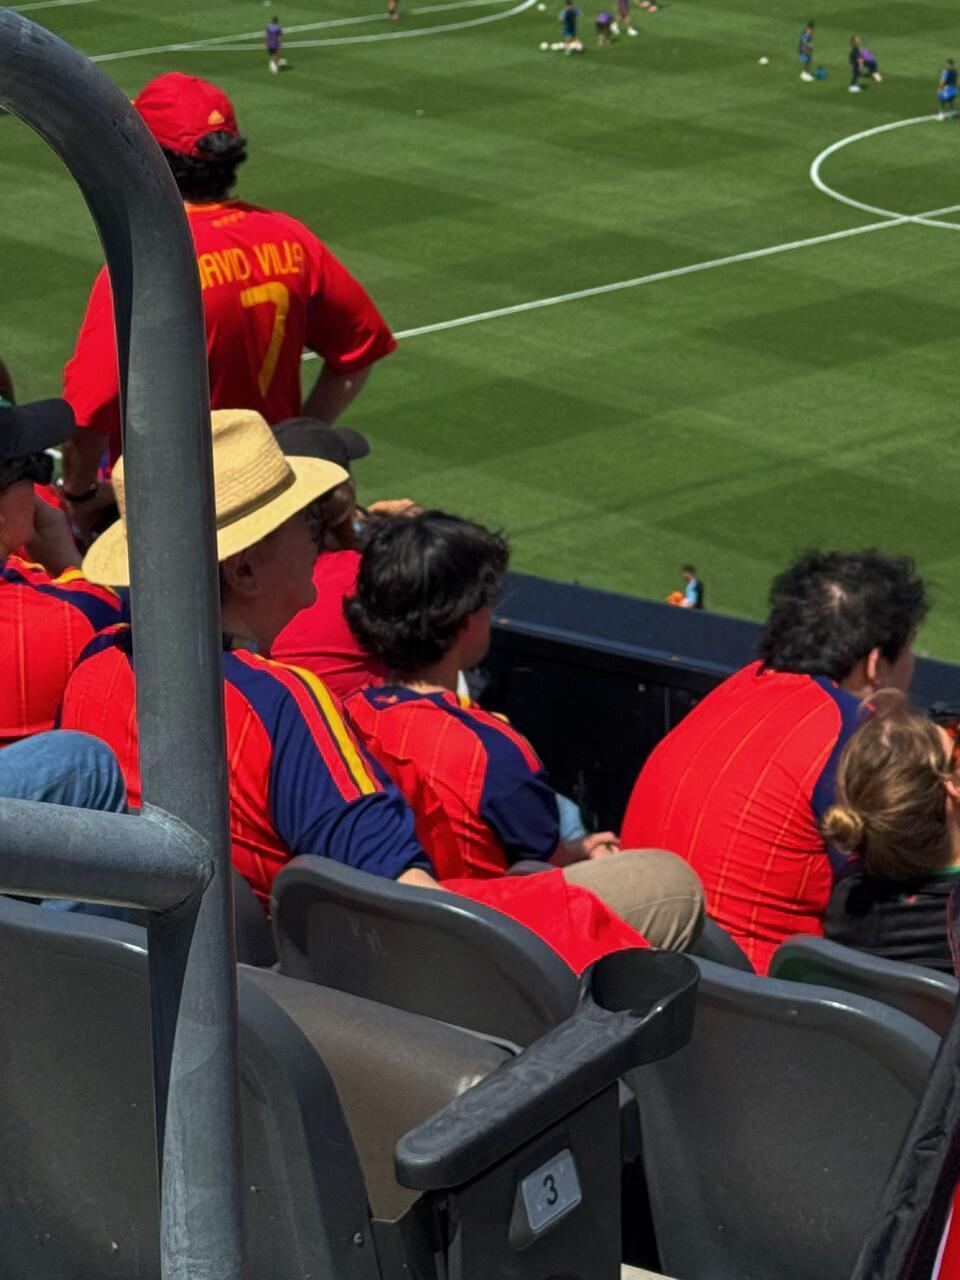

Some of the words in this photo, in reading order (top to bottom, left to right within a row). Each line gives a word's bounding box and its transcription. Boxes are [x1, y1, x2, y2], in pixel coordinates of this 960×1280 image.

[199, 247, 251, 289] AVID
[240, 281, 290, 397] 7
[543, 1174, 558, 1206] 3
